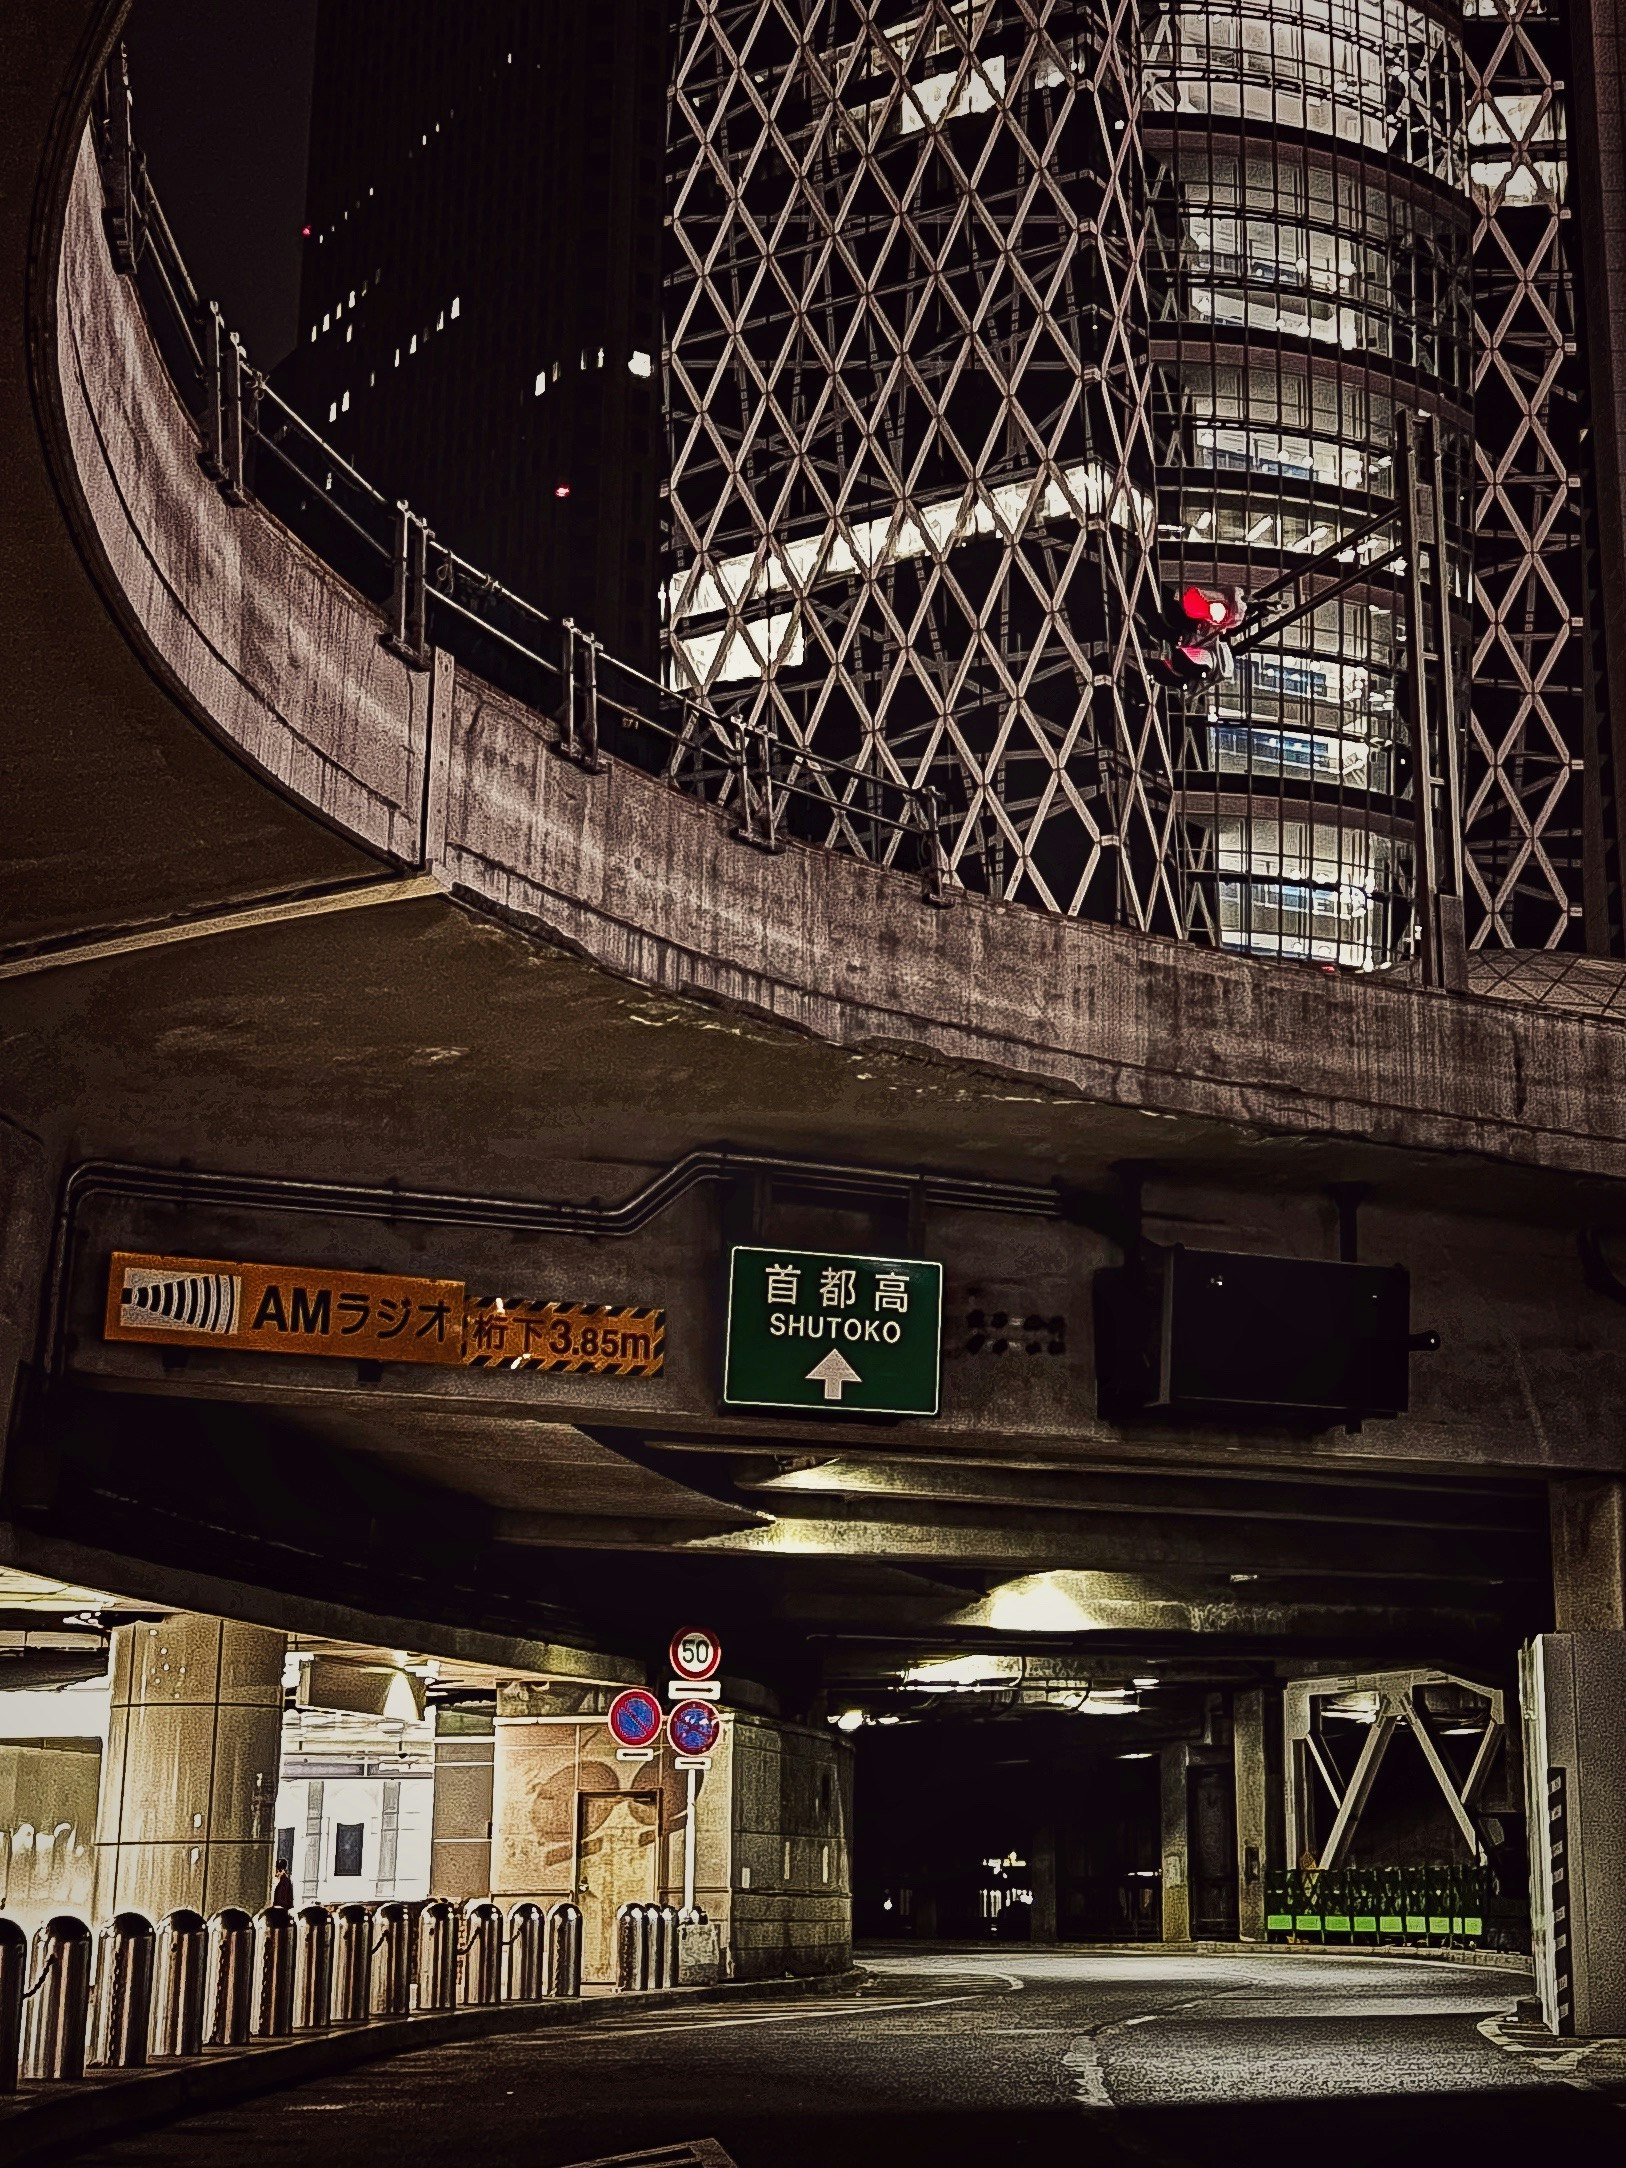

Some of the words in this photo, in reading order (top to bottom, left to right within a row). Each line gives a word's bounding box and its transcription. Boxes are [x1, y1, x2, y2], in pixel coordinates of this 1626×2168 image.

[765, 1262, 910, 1313] 首都高
[769, 1313, 902, 1344] SHUTOKO
[681, 1639, 710, 1664] 50
